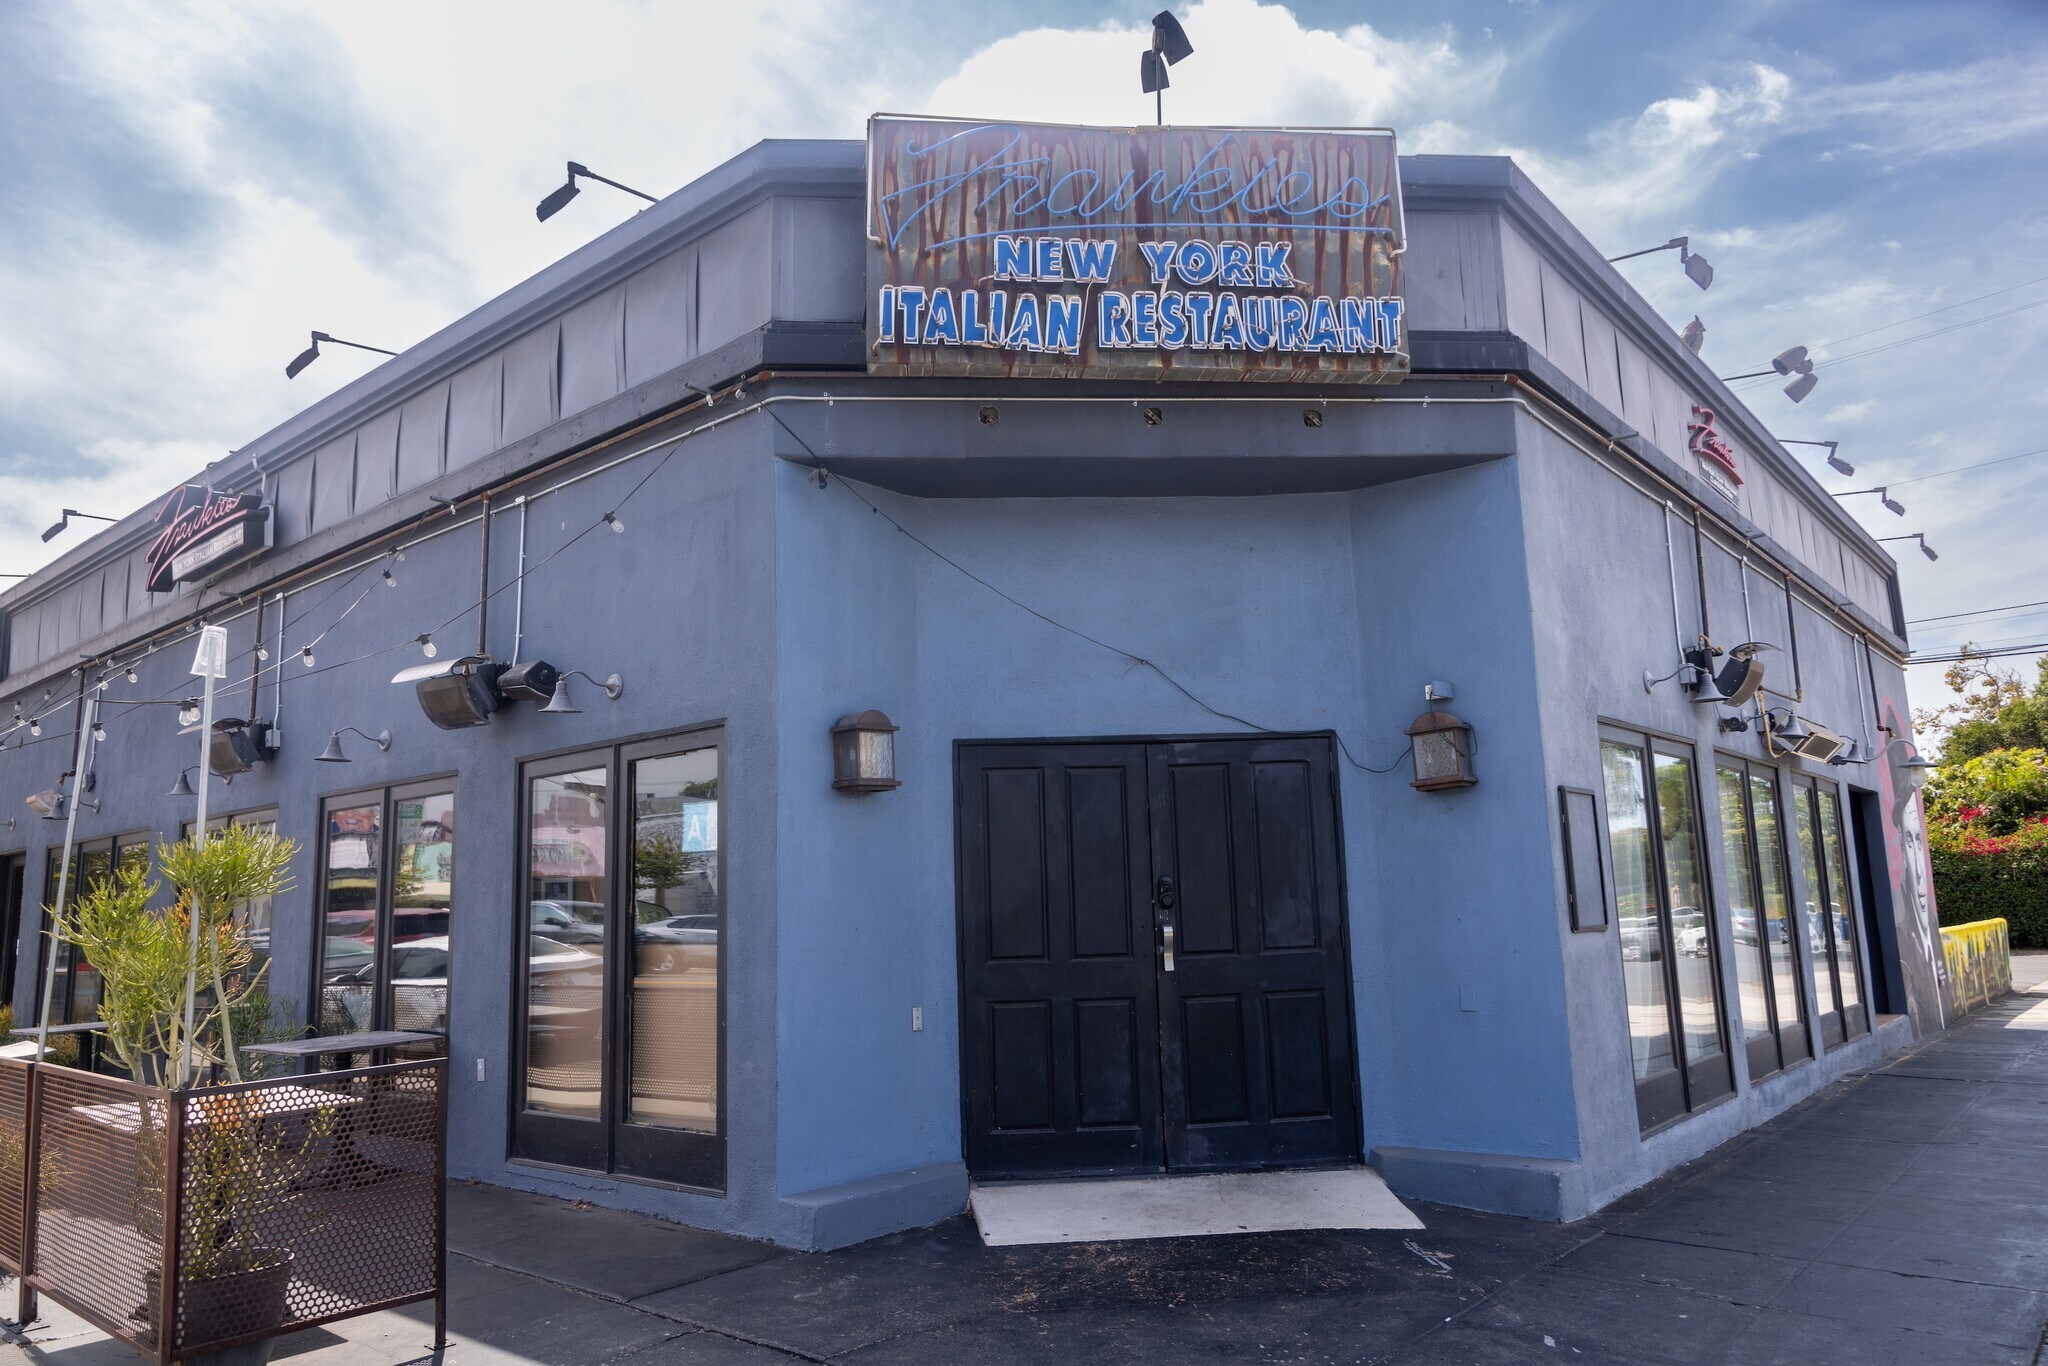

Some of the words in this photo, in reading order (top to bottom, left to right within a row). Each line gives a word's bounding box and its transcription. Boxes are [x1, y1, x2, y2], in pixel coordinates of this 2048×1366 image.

[993, 235, 1118, 284] NEW
[1139, 239, 1296, 288] YORK
[878, 283, 1083, 356] ITALIAN
[1098, 290, 1405, 354] RESTAURANT
[687, 813, 703, 842] A
